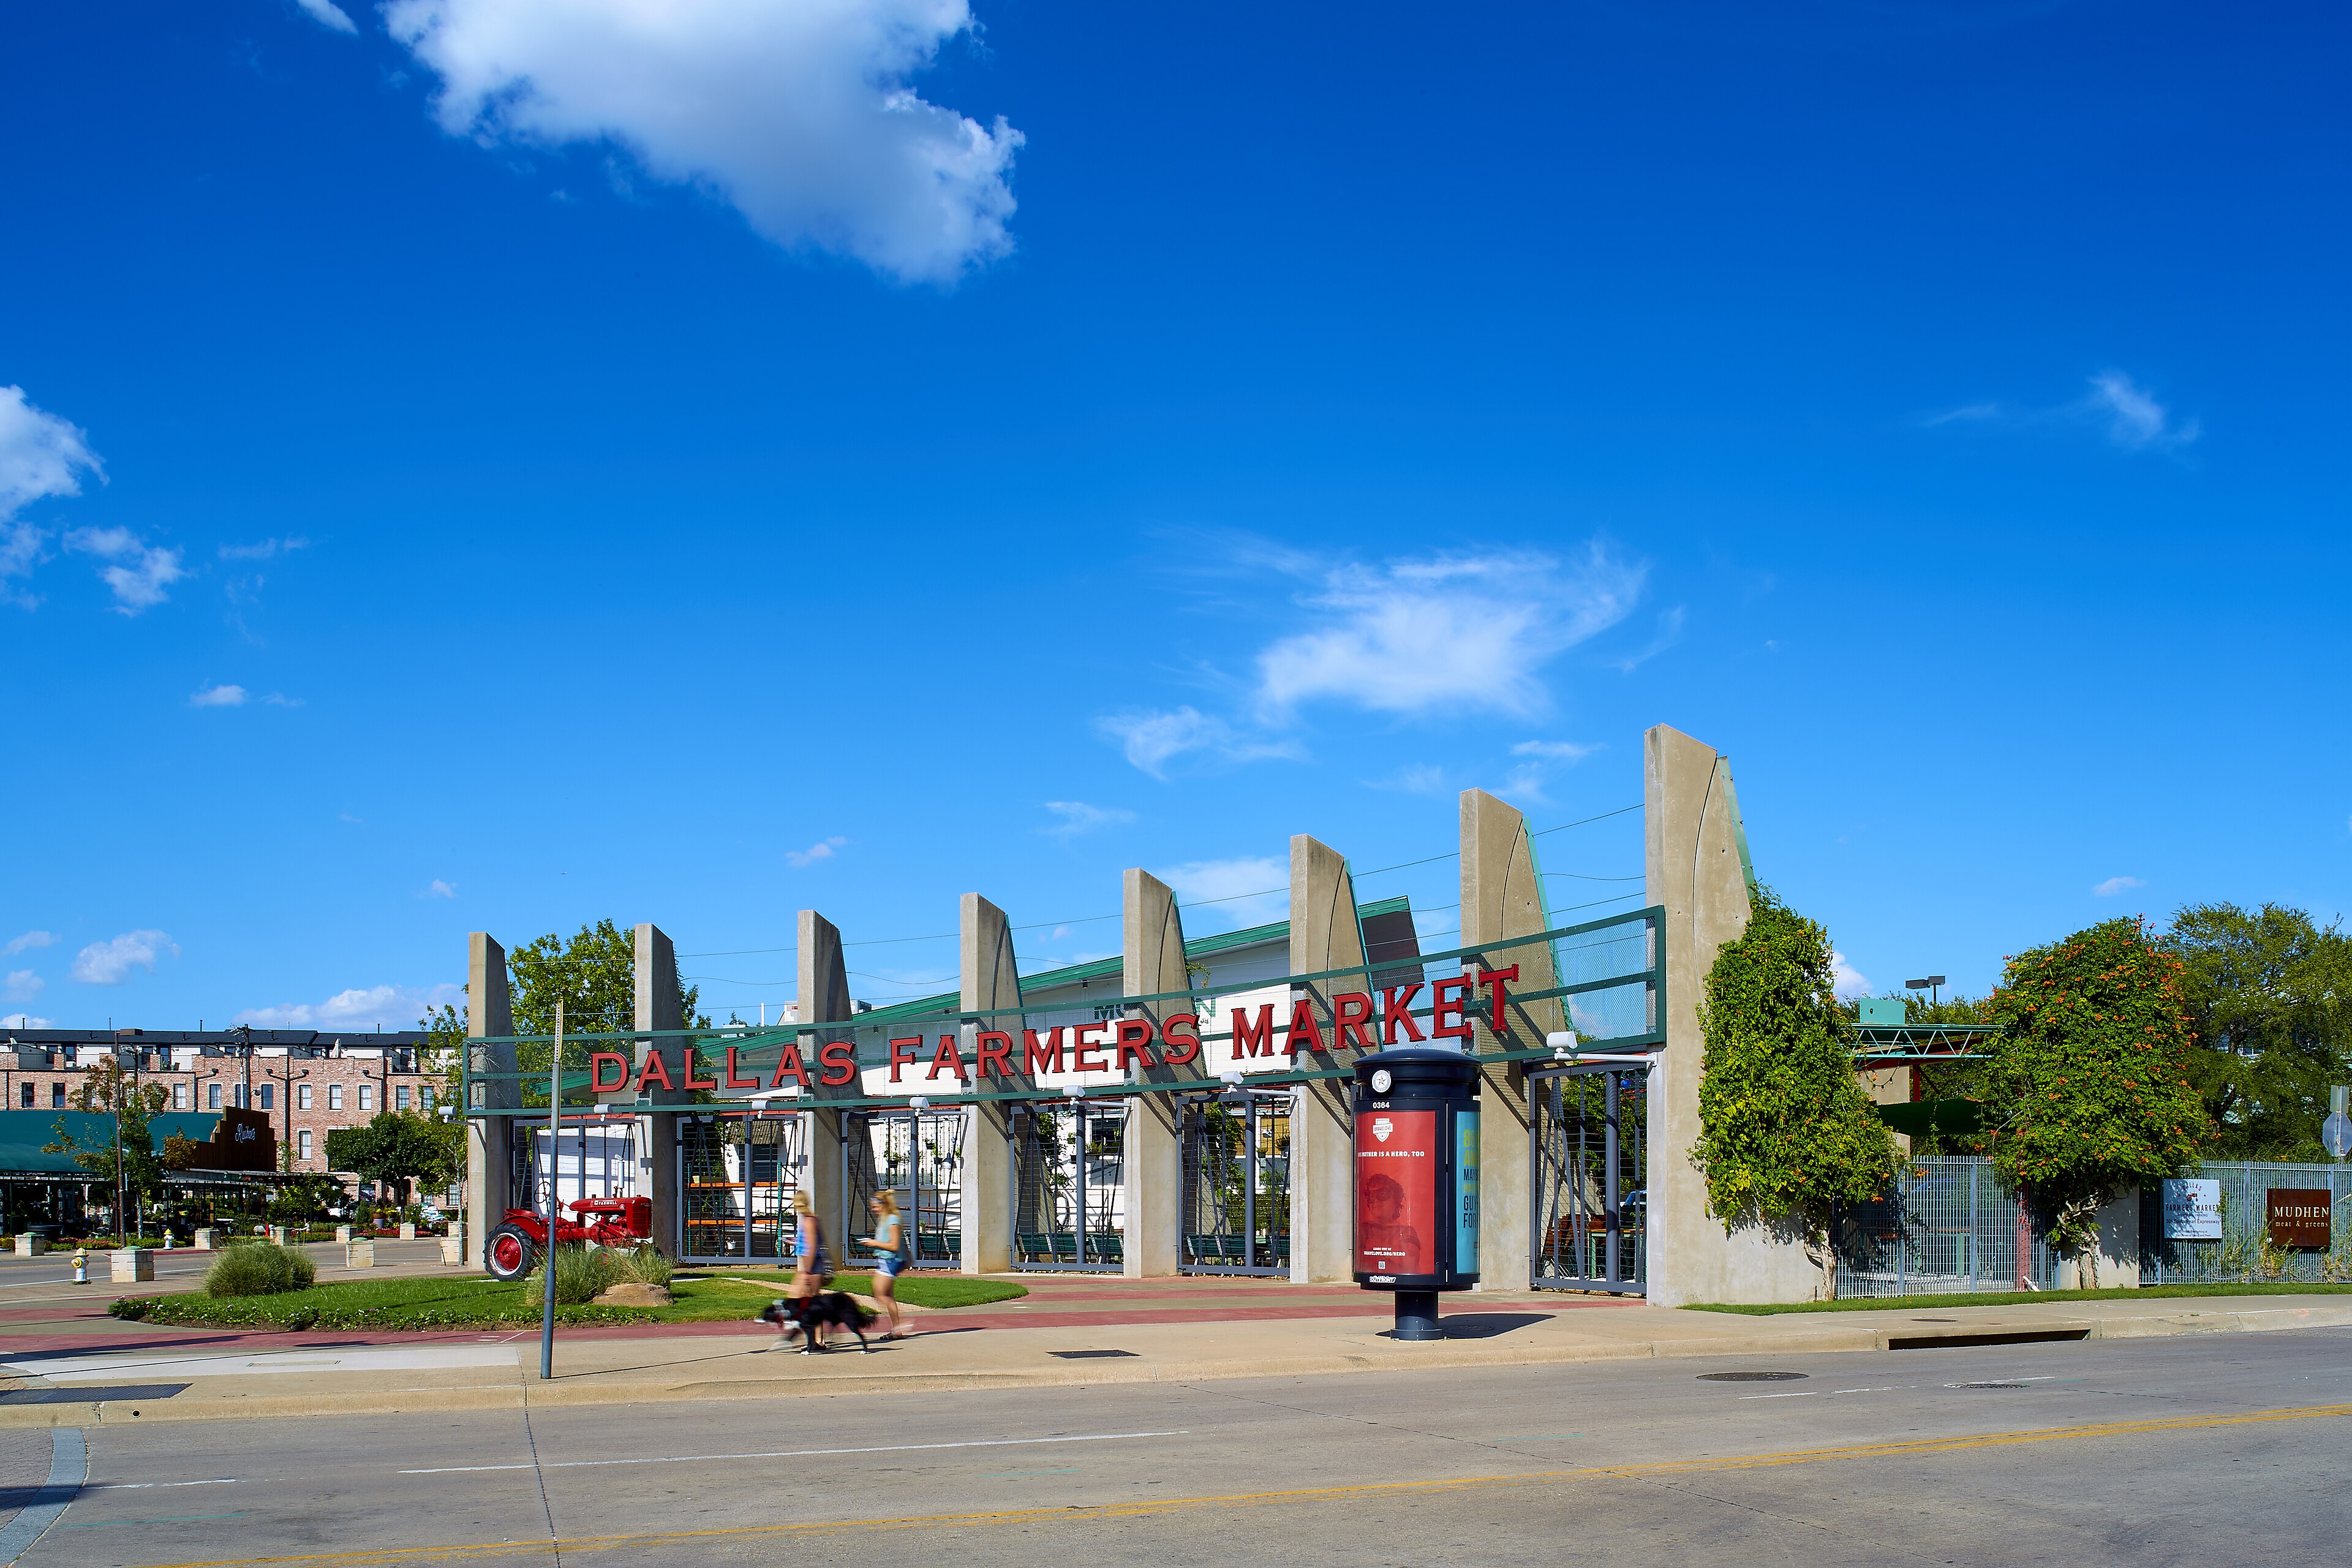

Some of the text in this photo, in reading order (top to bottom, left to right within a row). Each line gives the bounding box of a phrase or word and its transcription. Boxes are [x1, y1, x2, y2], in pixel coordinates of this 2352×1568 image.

[590, 963, 1519, 1093] DALLAS FARMERS MARKET
[2182, 1182, 2202, 1191] DALLAS
[2274, 1206, 2329, 1218] MUDHEN
